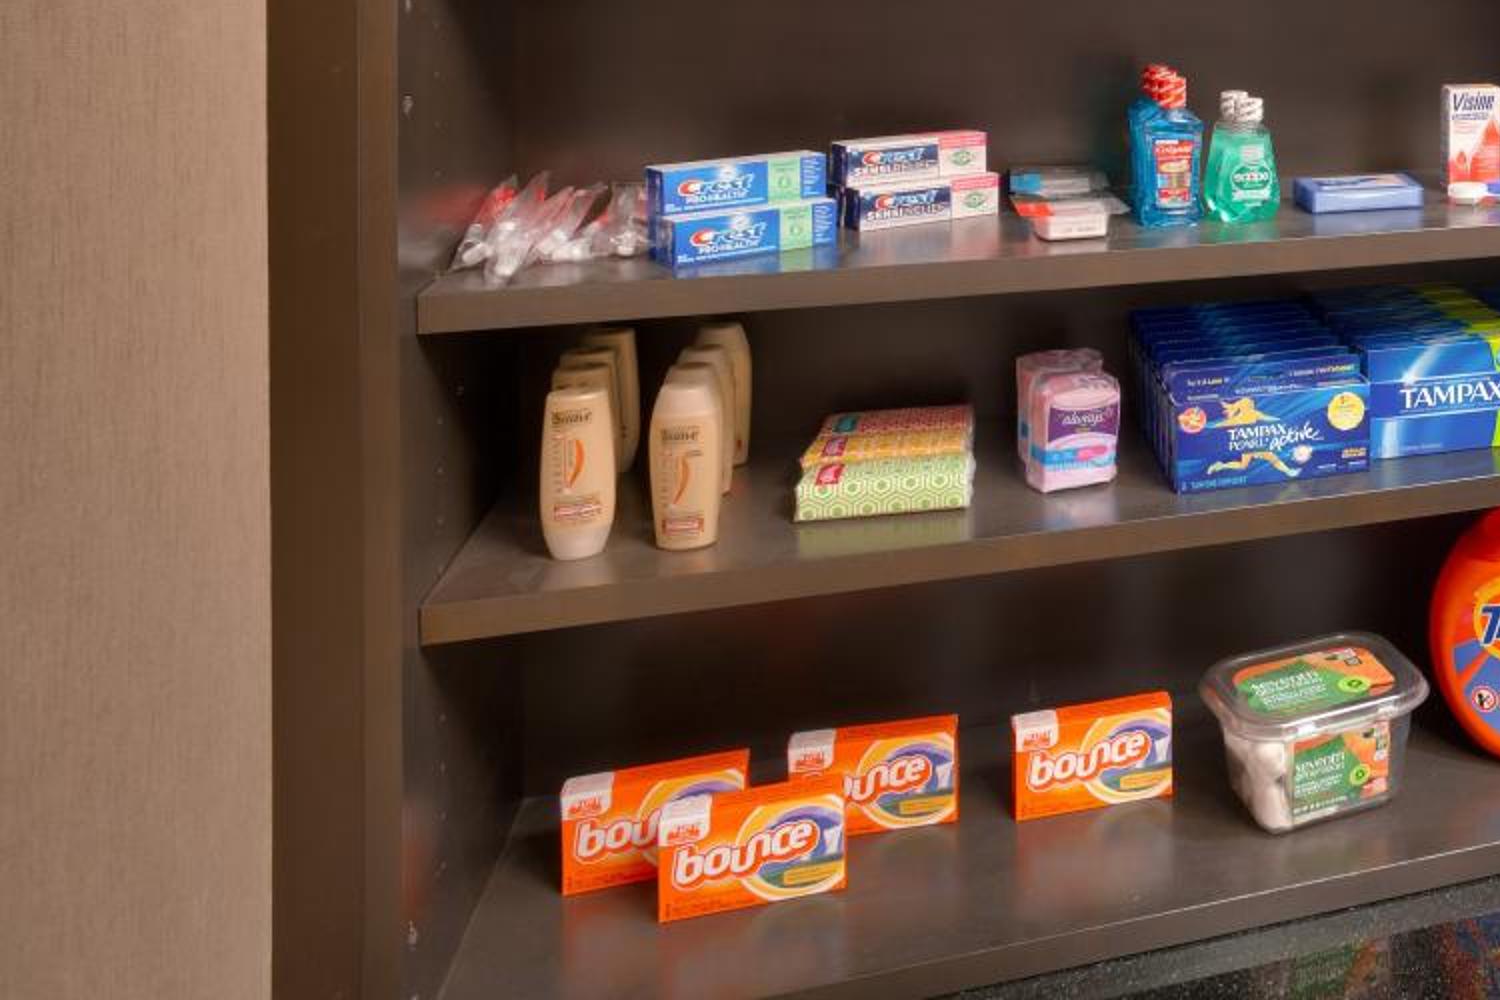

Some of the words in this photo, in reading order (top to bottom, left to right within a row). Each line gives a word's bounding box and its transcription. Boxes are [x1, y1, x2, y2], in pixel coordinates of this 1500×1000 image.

[1228, 424, 1288, 441] TAMPAX
[1029, 733, 1146, 786] bounce
[674, 820, 813, 885] bounce
